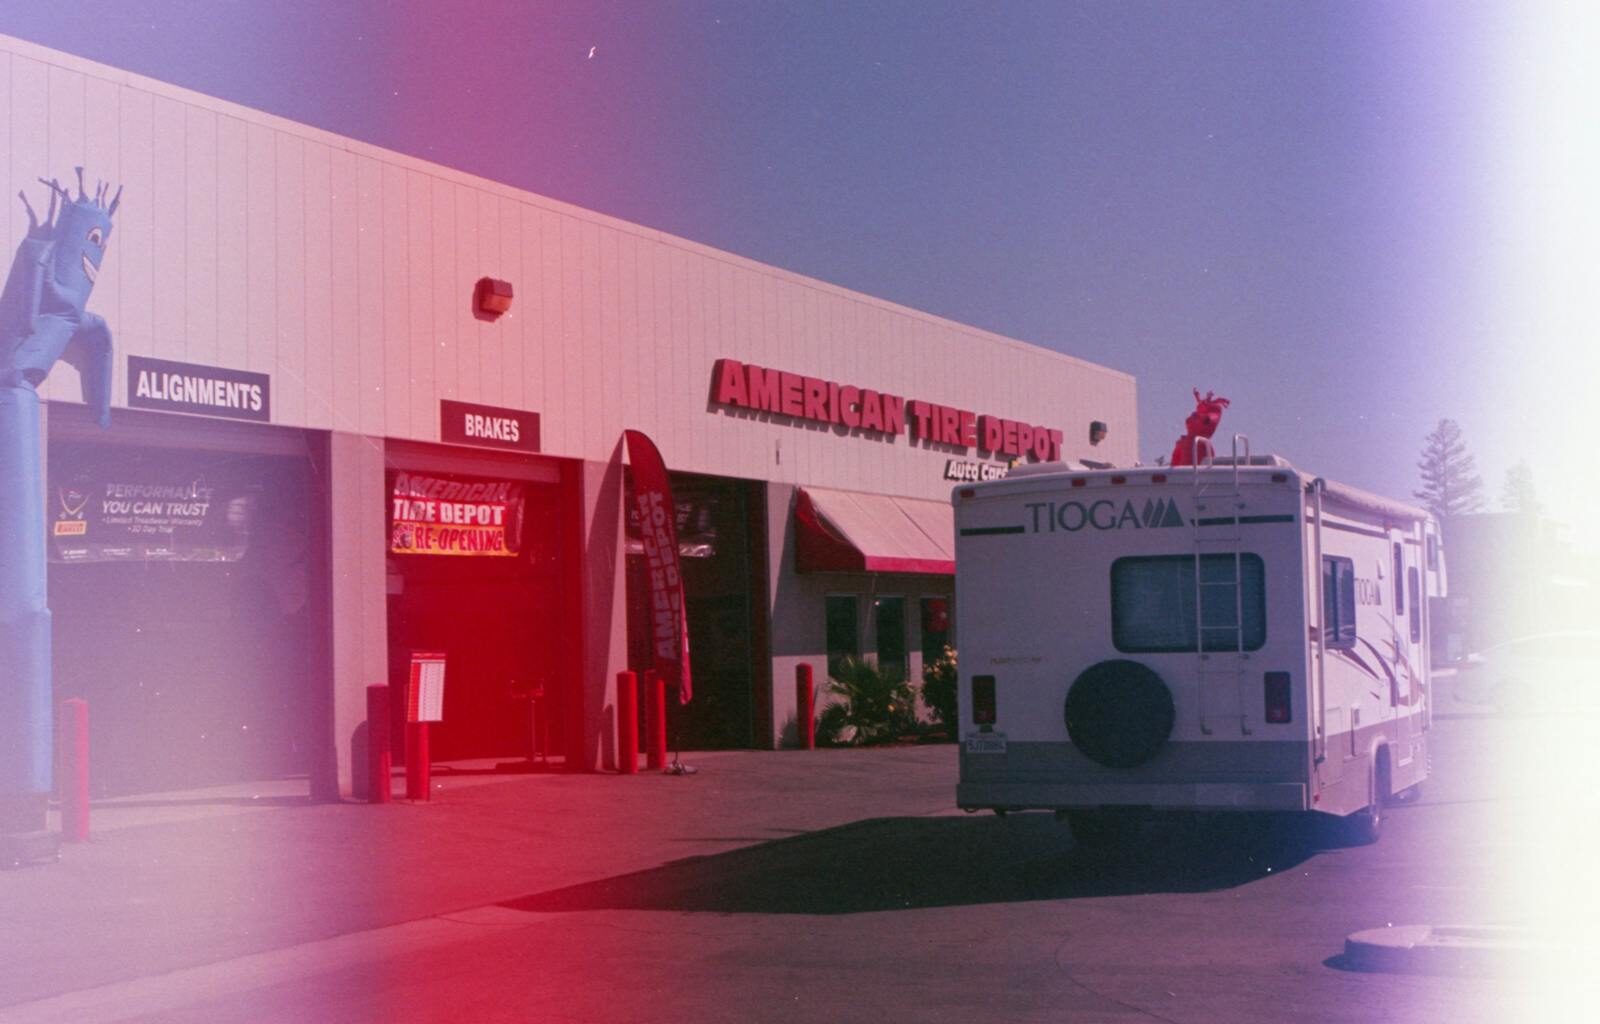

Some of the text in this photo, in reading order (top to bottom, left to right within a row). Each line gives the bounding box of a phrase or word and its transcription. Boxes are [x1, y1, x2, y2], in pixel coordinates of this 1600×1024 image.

[136, 370, 263, 411] ALIGNMENTS
[718, 359, 1063, 462] AMERICAN TIRE DEPOT
[464, 413, 520, 442] BRAKES
[947, 461, 979, 479] Auto
[106, 483, 216, 499] PERFORMANCE
[394, 472, 511, 501] AMERICAN
[102, 500, 210, 516] YOU CAN TRUST
[393, 499, 506, 525] TIRE DEPOT
[1025, 499, 1142, 533] TIOGA
[414, 527, 505, 552] RE-OPENING
[649, 491, 678, 586] DEPOT
[638, 495, 679, 660] AMERICAN
